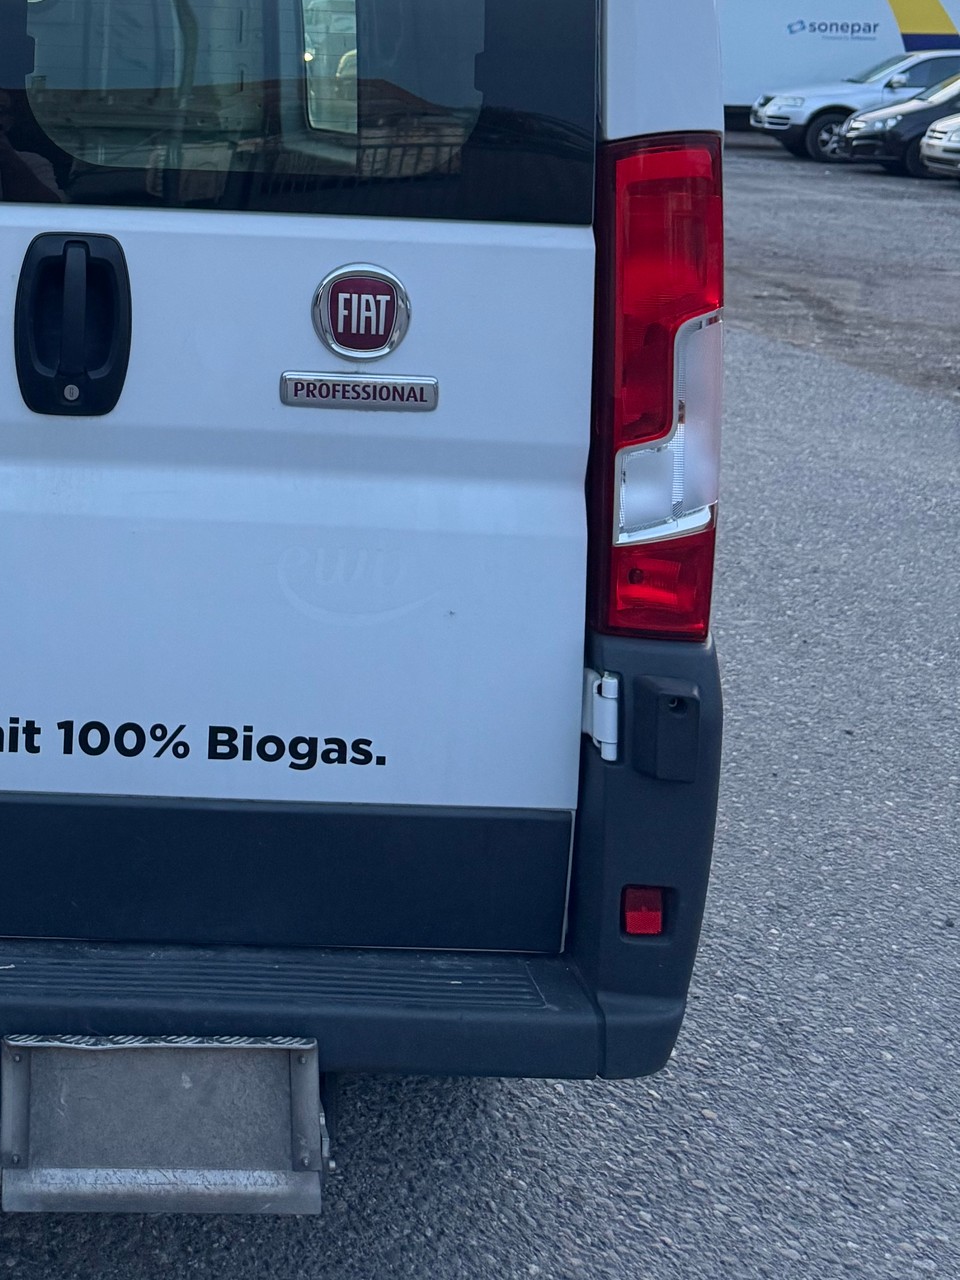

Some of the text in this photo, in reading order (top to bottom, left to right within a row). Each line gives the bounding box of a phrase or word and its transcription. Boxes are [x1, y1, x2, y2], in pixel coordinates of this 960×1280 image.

[808, 22, 879, 35] sonepar
[337, 292, 391, 335] FIAT
[293, 381, 428, 403] PROFESSIONAL
[56, 719, 191, 760] 100%
[207, 724, 387, 771] Biogas.
